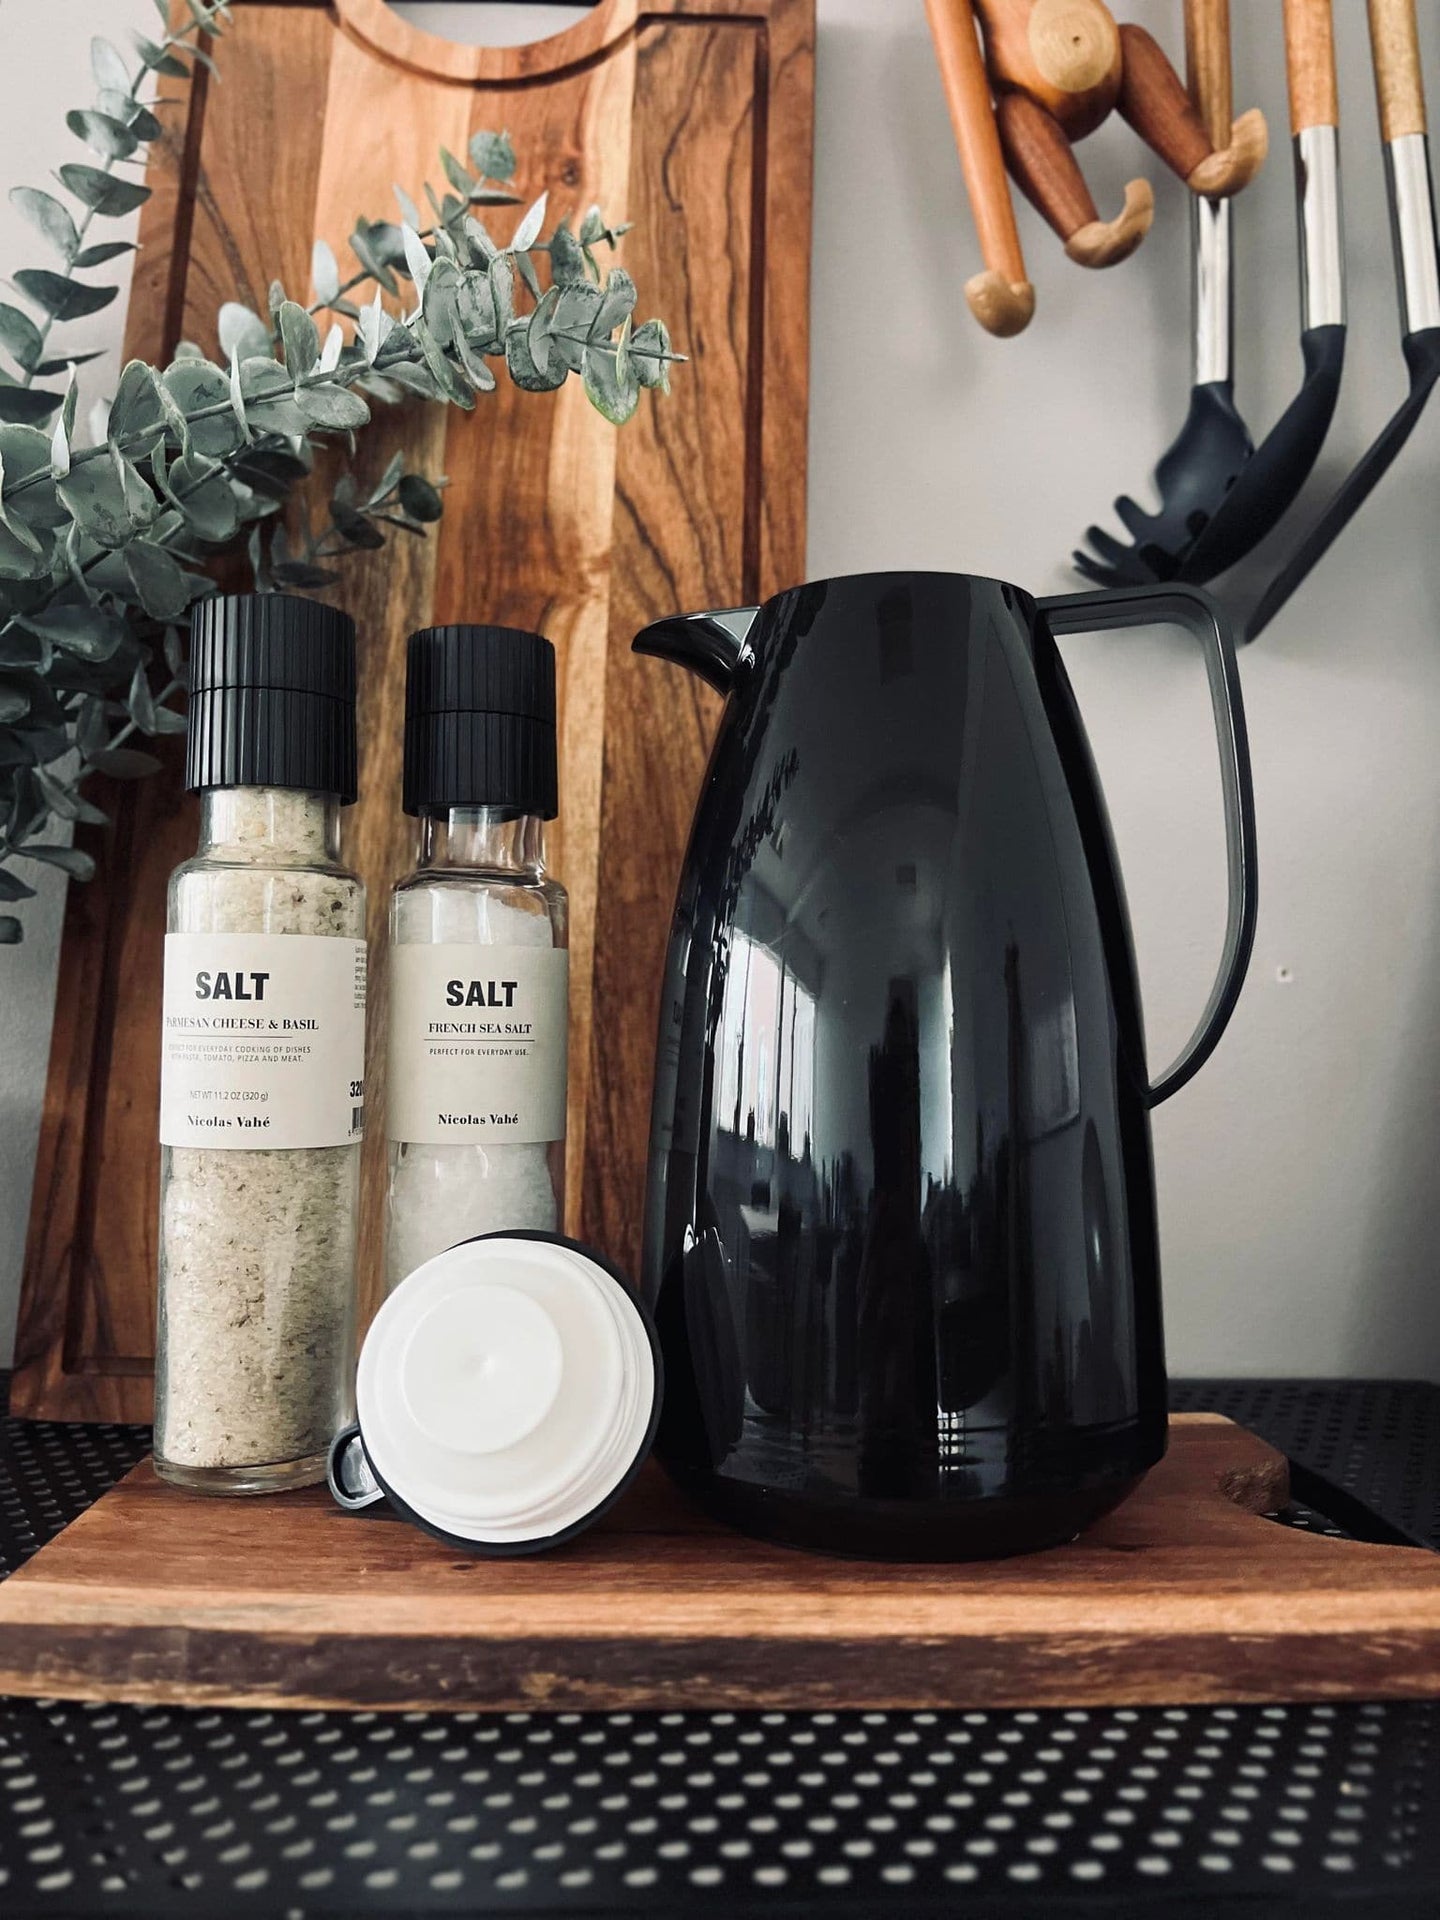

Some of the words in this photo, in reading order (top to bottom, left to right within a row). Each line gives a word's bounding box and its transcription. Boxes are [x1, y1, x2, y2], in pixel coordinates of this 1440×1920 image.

[195, 971, 270, 1001] SALT
[446, 979, 518, 1008] SALT
[166, 1016, 211, 1029] PARMESAN
[212, 1017, 265, 1030] CHEESE
[268, 1019, 279, 1030] &
[283, 1019, 320, 1031] BASIL
[428, 1022, 476, 1034] FRENCH
[479, 1023, 503, 1034] SEA
[505, 1023, 533, 1035] SALT
[235, 1045, 271, 1054] COOKING
[273, 1046, 283, 1054] OF
[286, 1046, 311, 1054] DISHES
[429, 1048, 459, 1056] PERFECT
[461, 1048, 475, 1056] FOR
[477, 1048, 513, 1056] EVERYDAY
[515, 1048, 530, 1056] USE.
[203, 1054, 235, 1063] TOMATO,
[237, 1055, 260, 1063] PIZZA
[262, 1055, 279, 1063] AND
[281, 1055, 304, 1063] MEAT.
[230, 1091, 241, 1101] OZ
[242, 1091, 259, 1101] (320
[260, 1092, 269, 1103] g)
[187, 1115, 232, 1127] Nicolas
[237, 1115, 271, 1128] Vahé
[438, 1113, 486, 1125] Nicolas
[489, 1113, 519, 1125] Vahé
